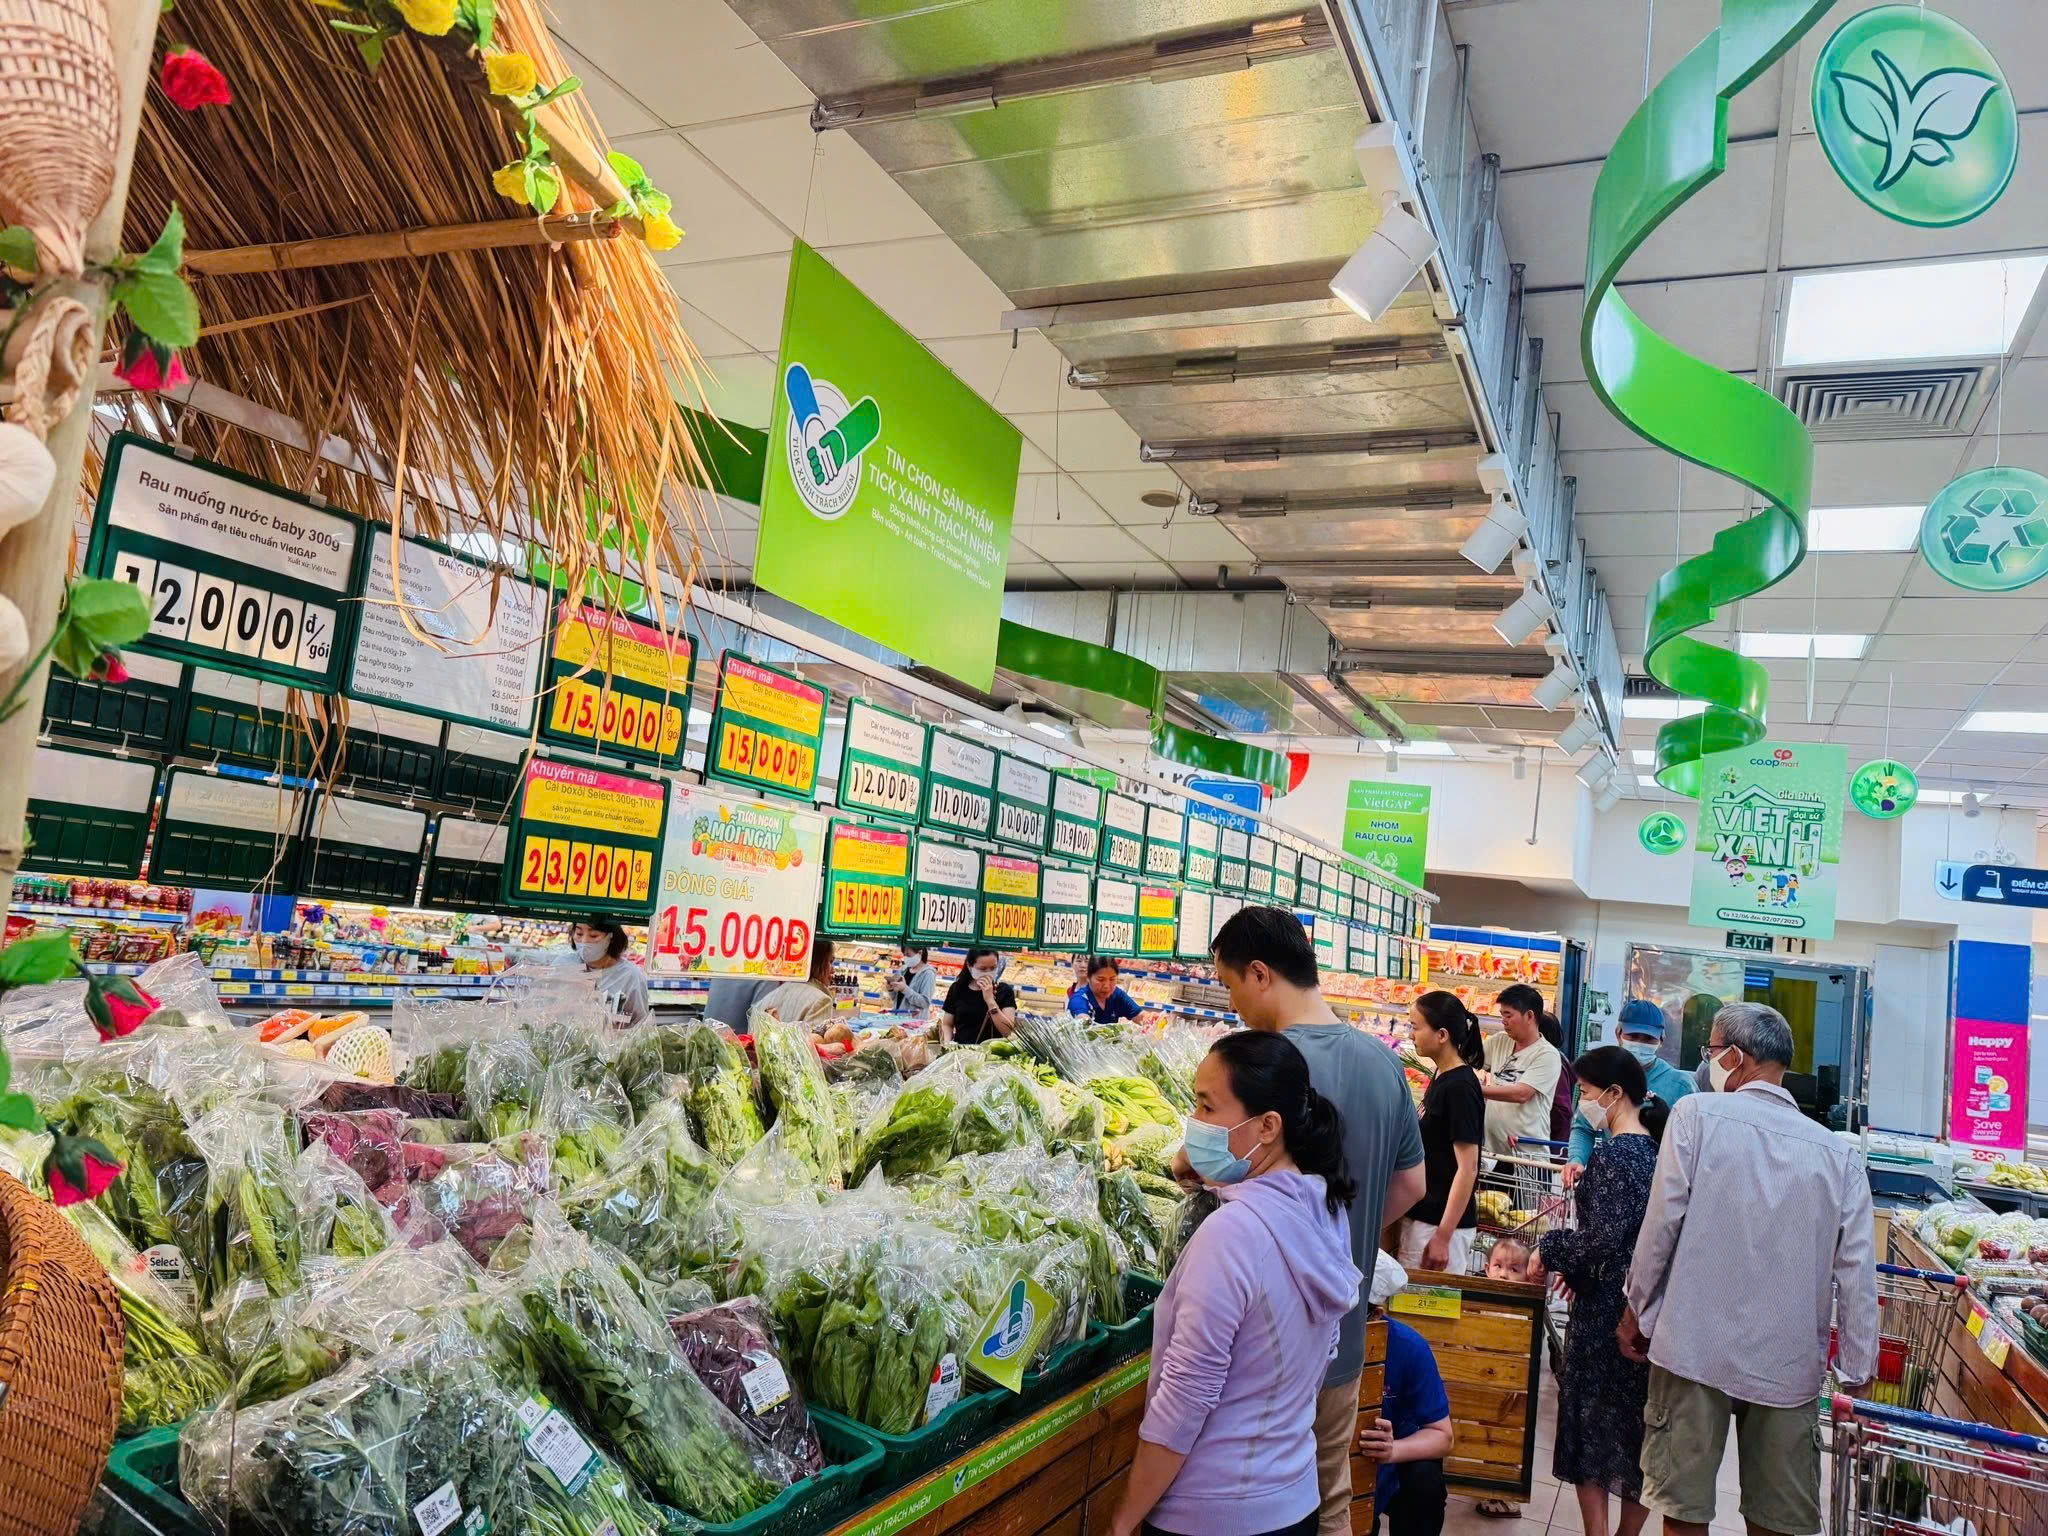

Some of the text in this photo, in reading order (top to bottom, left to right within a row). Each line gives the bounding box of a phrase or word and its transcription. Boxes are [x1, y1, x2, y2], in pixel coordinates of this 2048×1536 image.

[792, 437, 801, 465] TICK
[798, 468, 815, 499] XANH
[815, 494, 838, 508] TRÁCH
[886, 445, 994, 537] TIN CHỌN SẢN PHẨM
[139, 470, 341, 552] Rau muống nước baby 300g
[869, 462, 1001, 566] TICK XANH TRÁCH NHIỆM
[158, 502, 317, 560] Sản phẩm đạt tiêu chuẩn VietGAP
[758, 672, 774, 684] mãi
[561, 690, 656, 743] 15.000
[728, 731, 798, 777] 15.000
[531, 759, 598, 785] Khuyến mãi
[854, 767, 907, 803] 12.000
[587, 788, 656, 809] Select 300g-TNX
[934, 789, 980, 821] 11.000
[1364, 797, 1411, 809] VietGAP
[711, 814, 782, 851] MỖI NGÀY
[1001, 807, 1036, 836] 10.000
[1055, 823, 1090, 850] 11.900
[1355, 832, 1374, 840] RAU
[526, 847, 628, 894] 23.900
[664, 865, 755, 902] ĐỒNG GIÁ:
[2011, 878, 2036, 889] ĐIỂM
[836, 887, 889, 917] 15.000
[922, 897, 967, 925] 12.500
[657, 905, 811, 963] 15.000Đ
[1046, 916, 1080, 939] 16.900
[1761, 915, 1799, 925] 02/07/2025
[1731, 935, 1768, 950] EXIT
[1782, 936, 1807, 954] T1
[1968, 1036, 2014, 1048] Happy
[1973, 1119, 2003, 1130] Save
[150, 1257, 179, 1266] Select
[967, 1468, 978, 1480] TIN
[978, 1456, 997, 1474] CHỌN
[883, 1495, 932, 1531] TRÁCH NHIỆM
